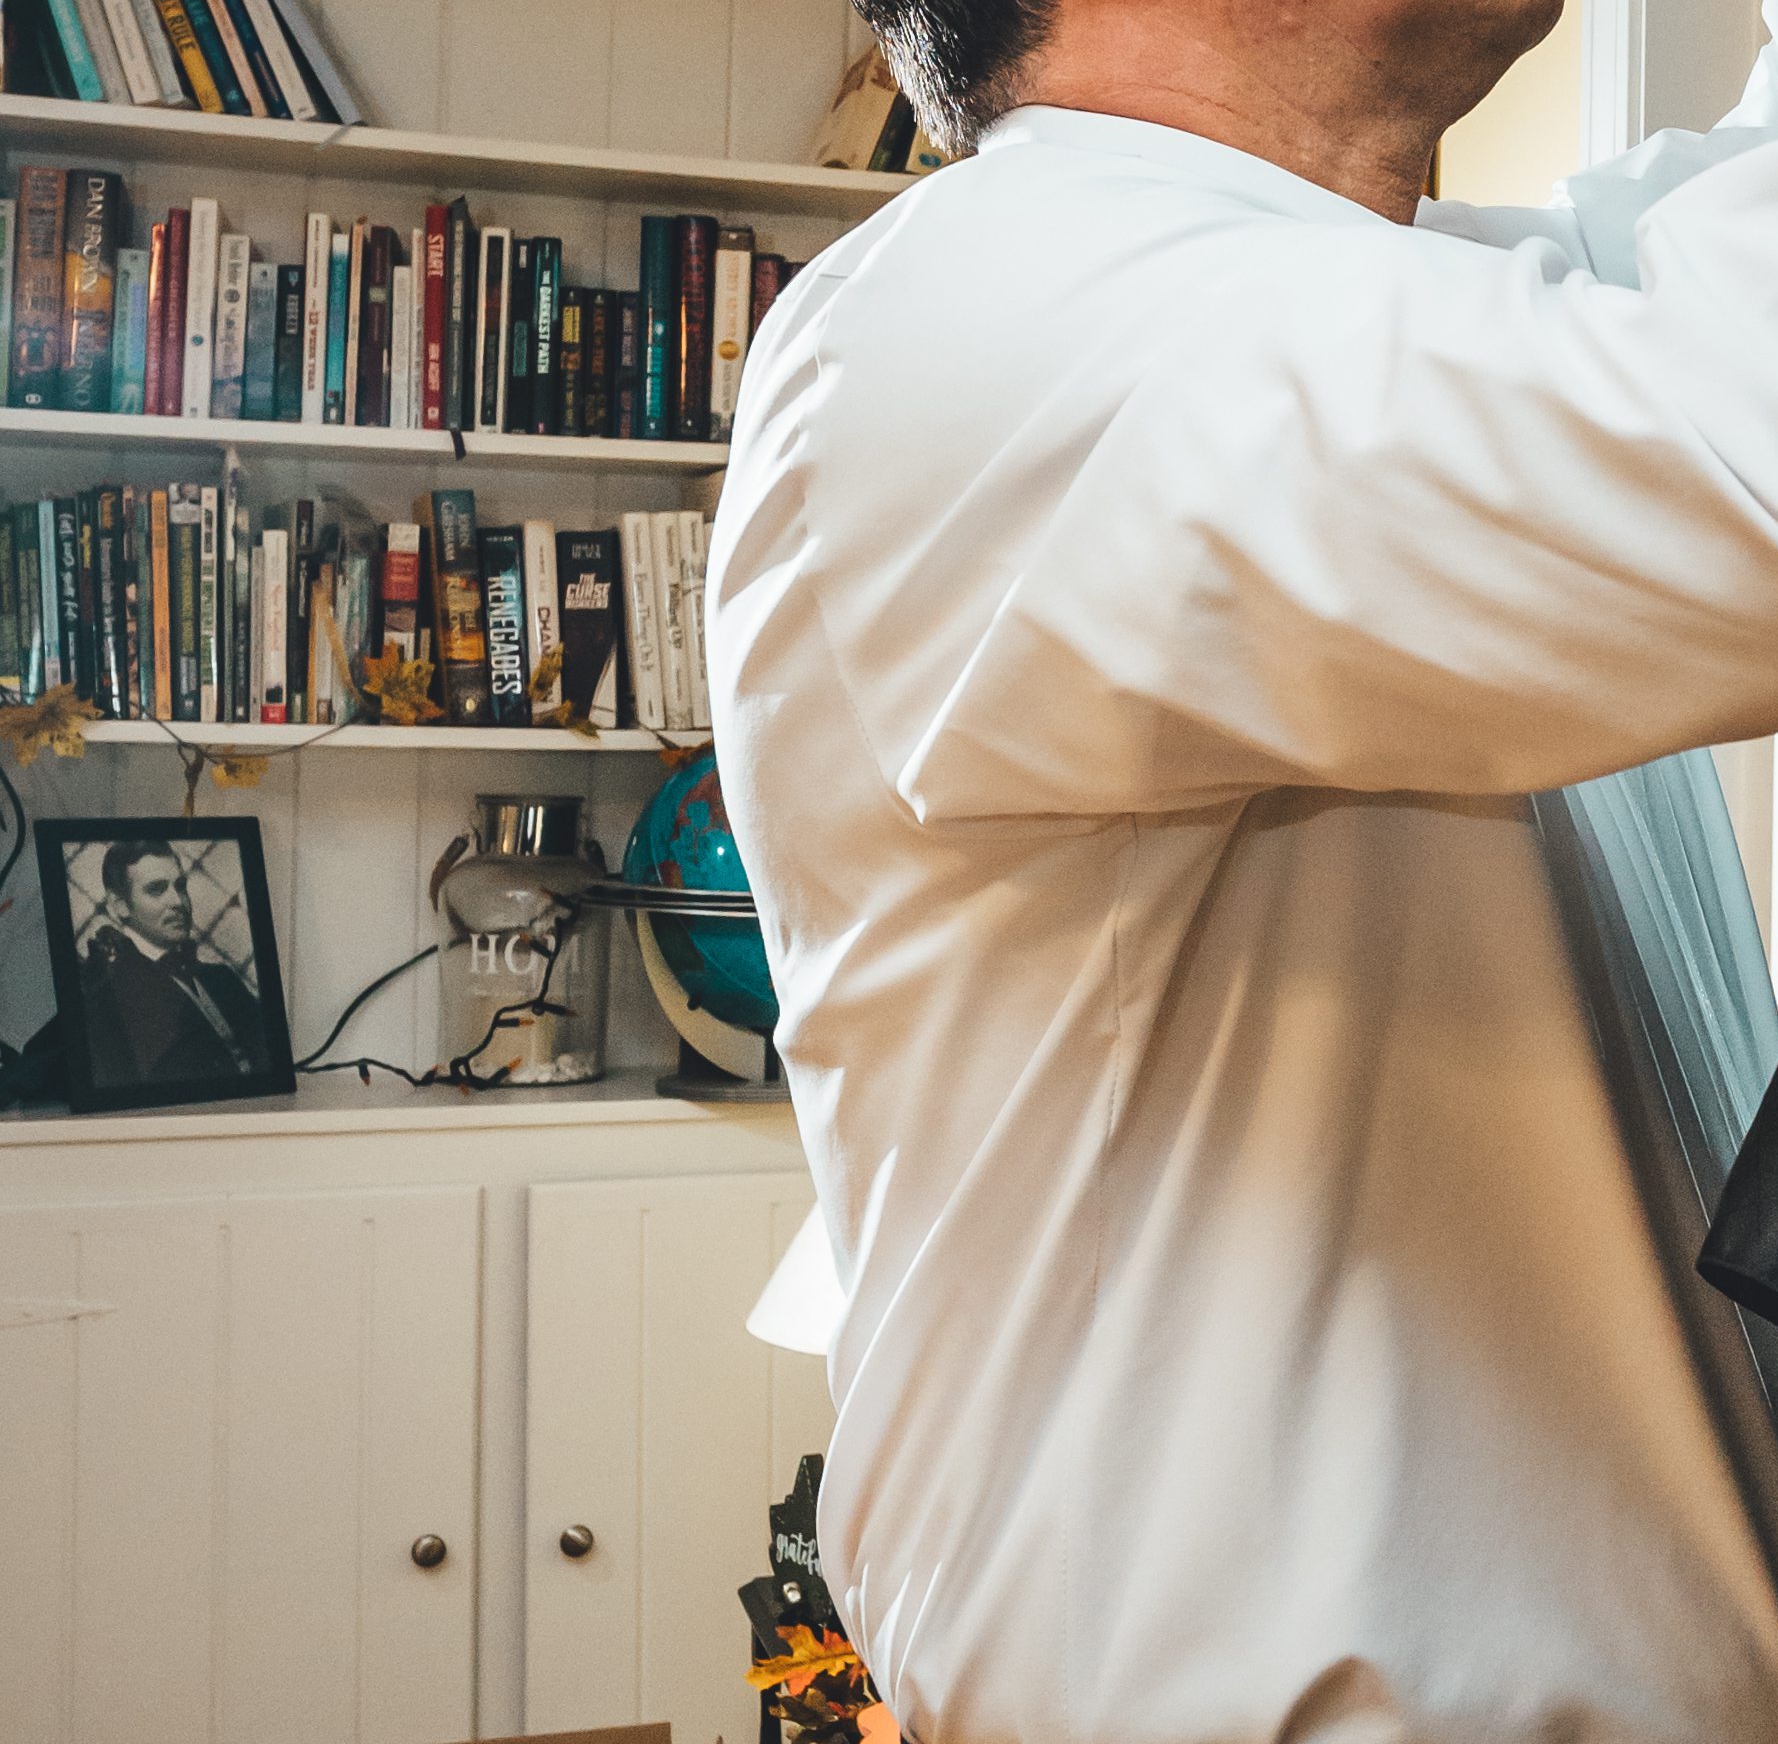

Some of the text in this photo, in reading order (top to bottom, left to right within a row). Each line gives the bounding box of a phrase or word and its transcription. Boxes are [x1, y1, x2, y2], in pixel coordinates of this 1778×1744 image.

[165, 14, 197, 54] RULE
[84, 176, 106, 221] DAN
[427, 233, 445, 278] START
[565, 581, 612, 600] CURSE
[487, 575, 523, 696] RENEGADES
